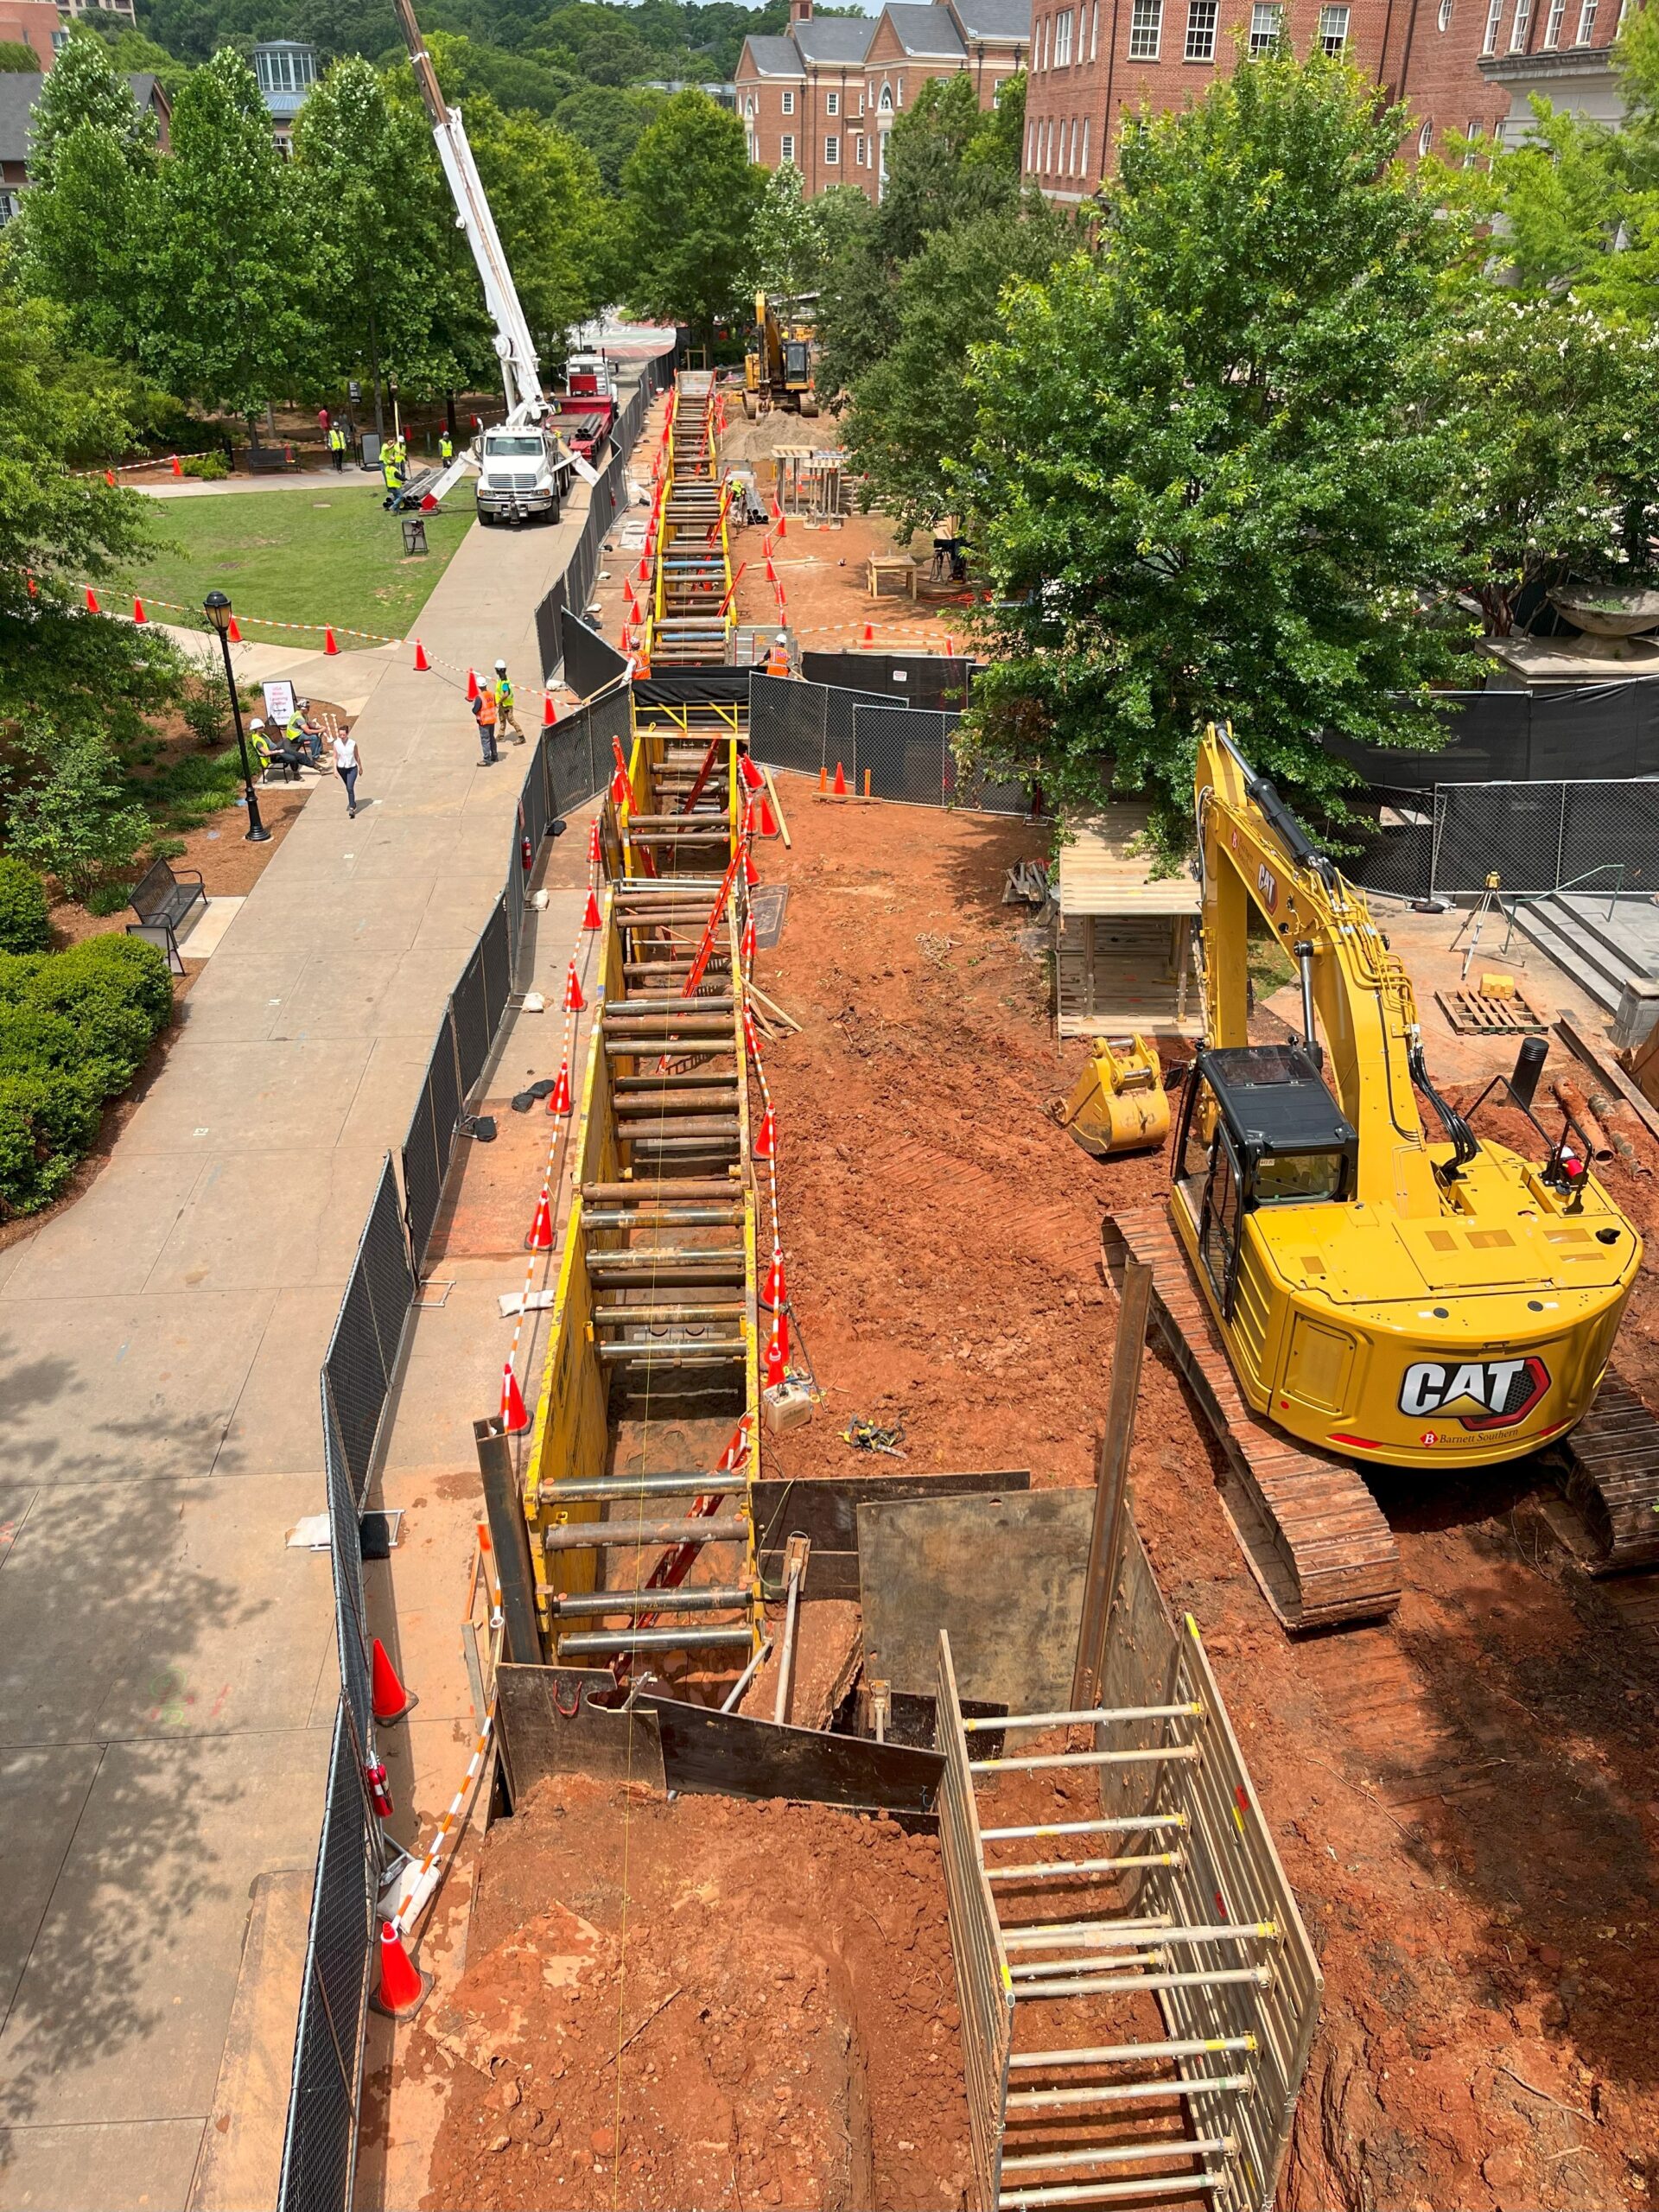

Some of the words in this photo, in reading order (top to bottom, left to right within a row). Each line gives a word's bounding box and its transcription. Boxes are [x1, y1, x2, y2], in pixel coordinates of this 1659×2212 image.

[1258, 862, 1275, 904] CAT
[1401, 1359, 1525, 1415] CAT
[1424, 1433, 1435, 1444] B
[1440, 1433, 1475, 1444] Barnett
[1477, 1428, 1518, 1442] Southern
